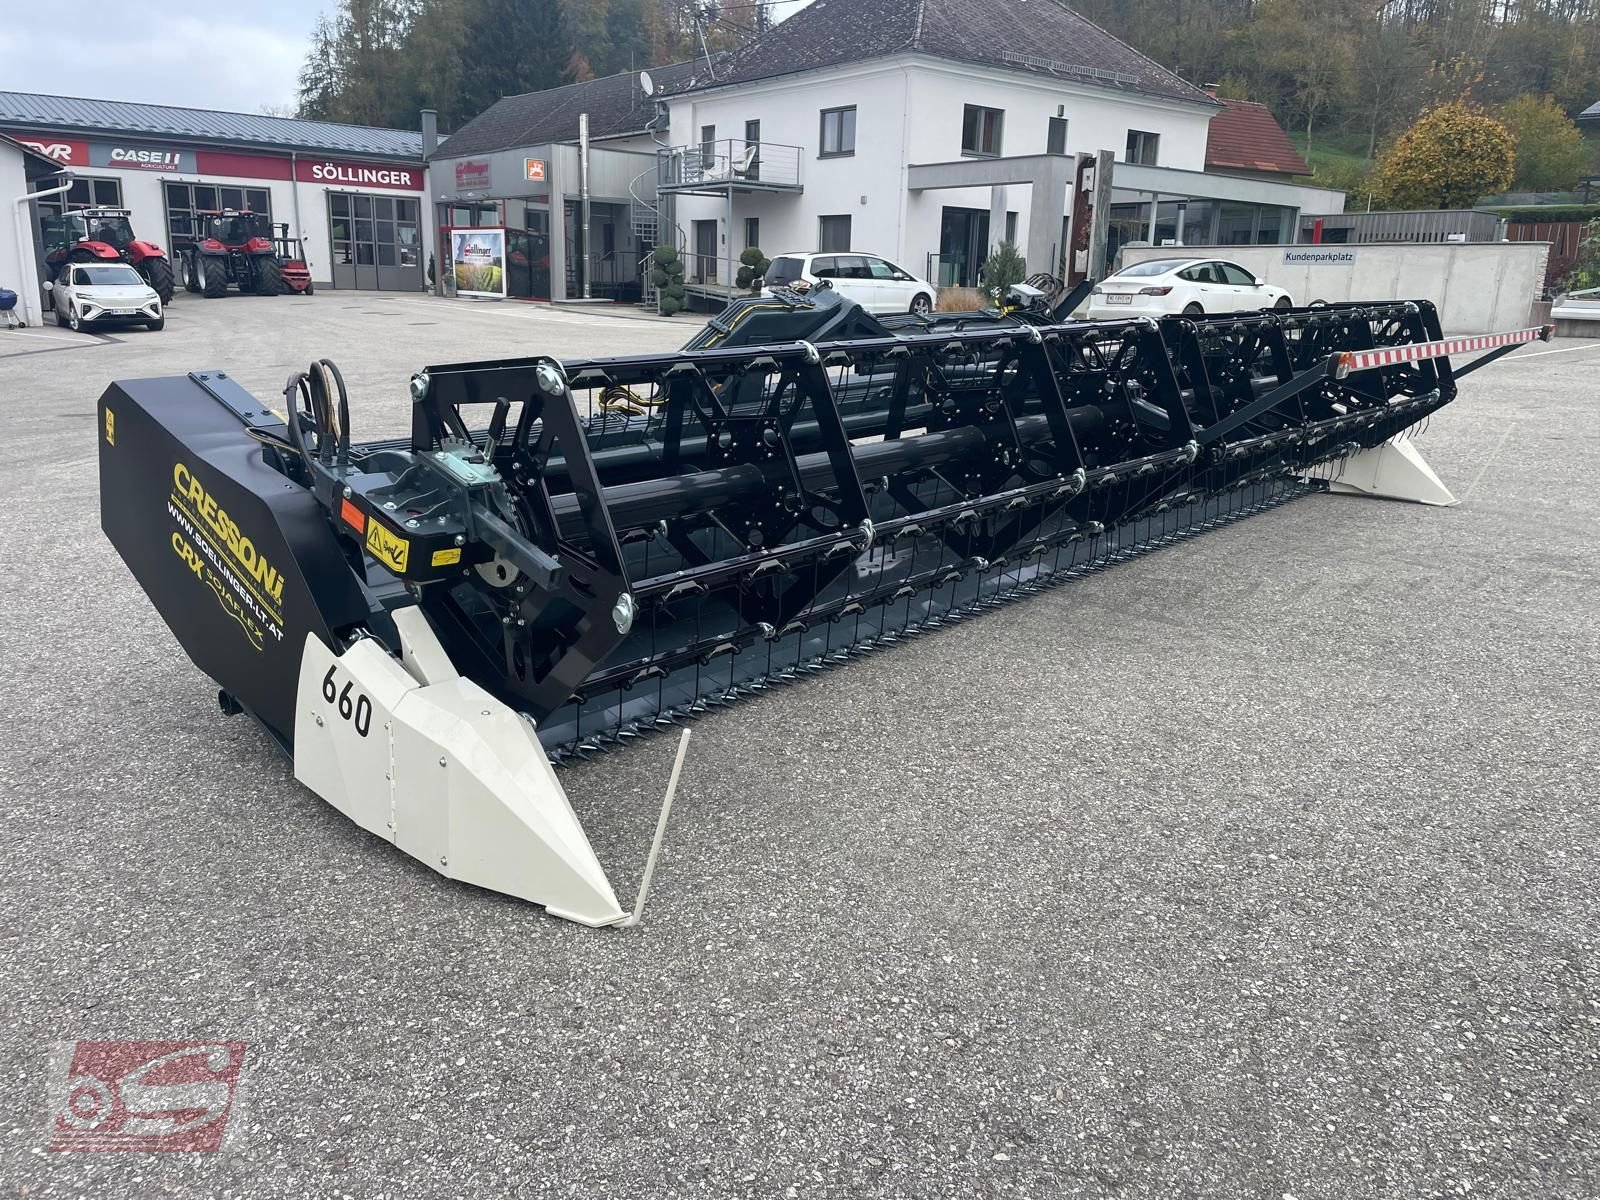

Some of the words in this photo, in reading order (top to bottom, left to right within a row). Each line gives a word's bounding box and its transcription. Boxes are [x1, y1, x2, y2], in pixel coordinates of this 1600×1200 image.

[111, 148, 162, 163] CASE
[312, 162, 412, 186] SÖLLINGER
[1285, 250, 1354, 263] Kundenparkplatz
[171, 531, 205, 580] CRX
[322, 663, 373, 738] 660
